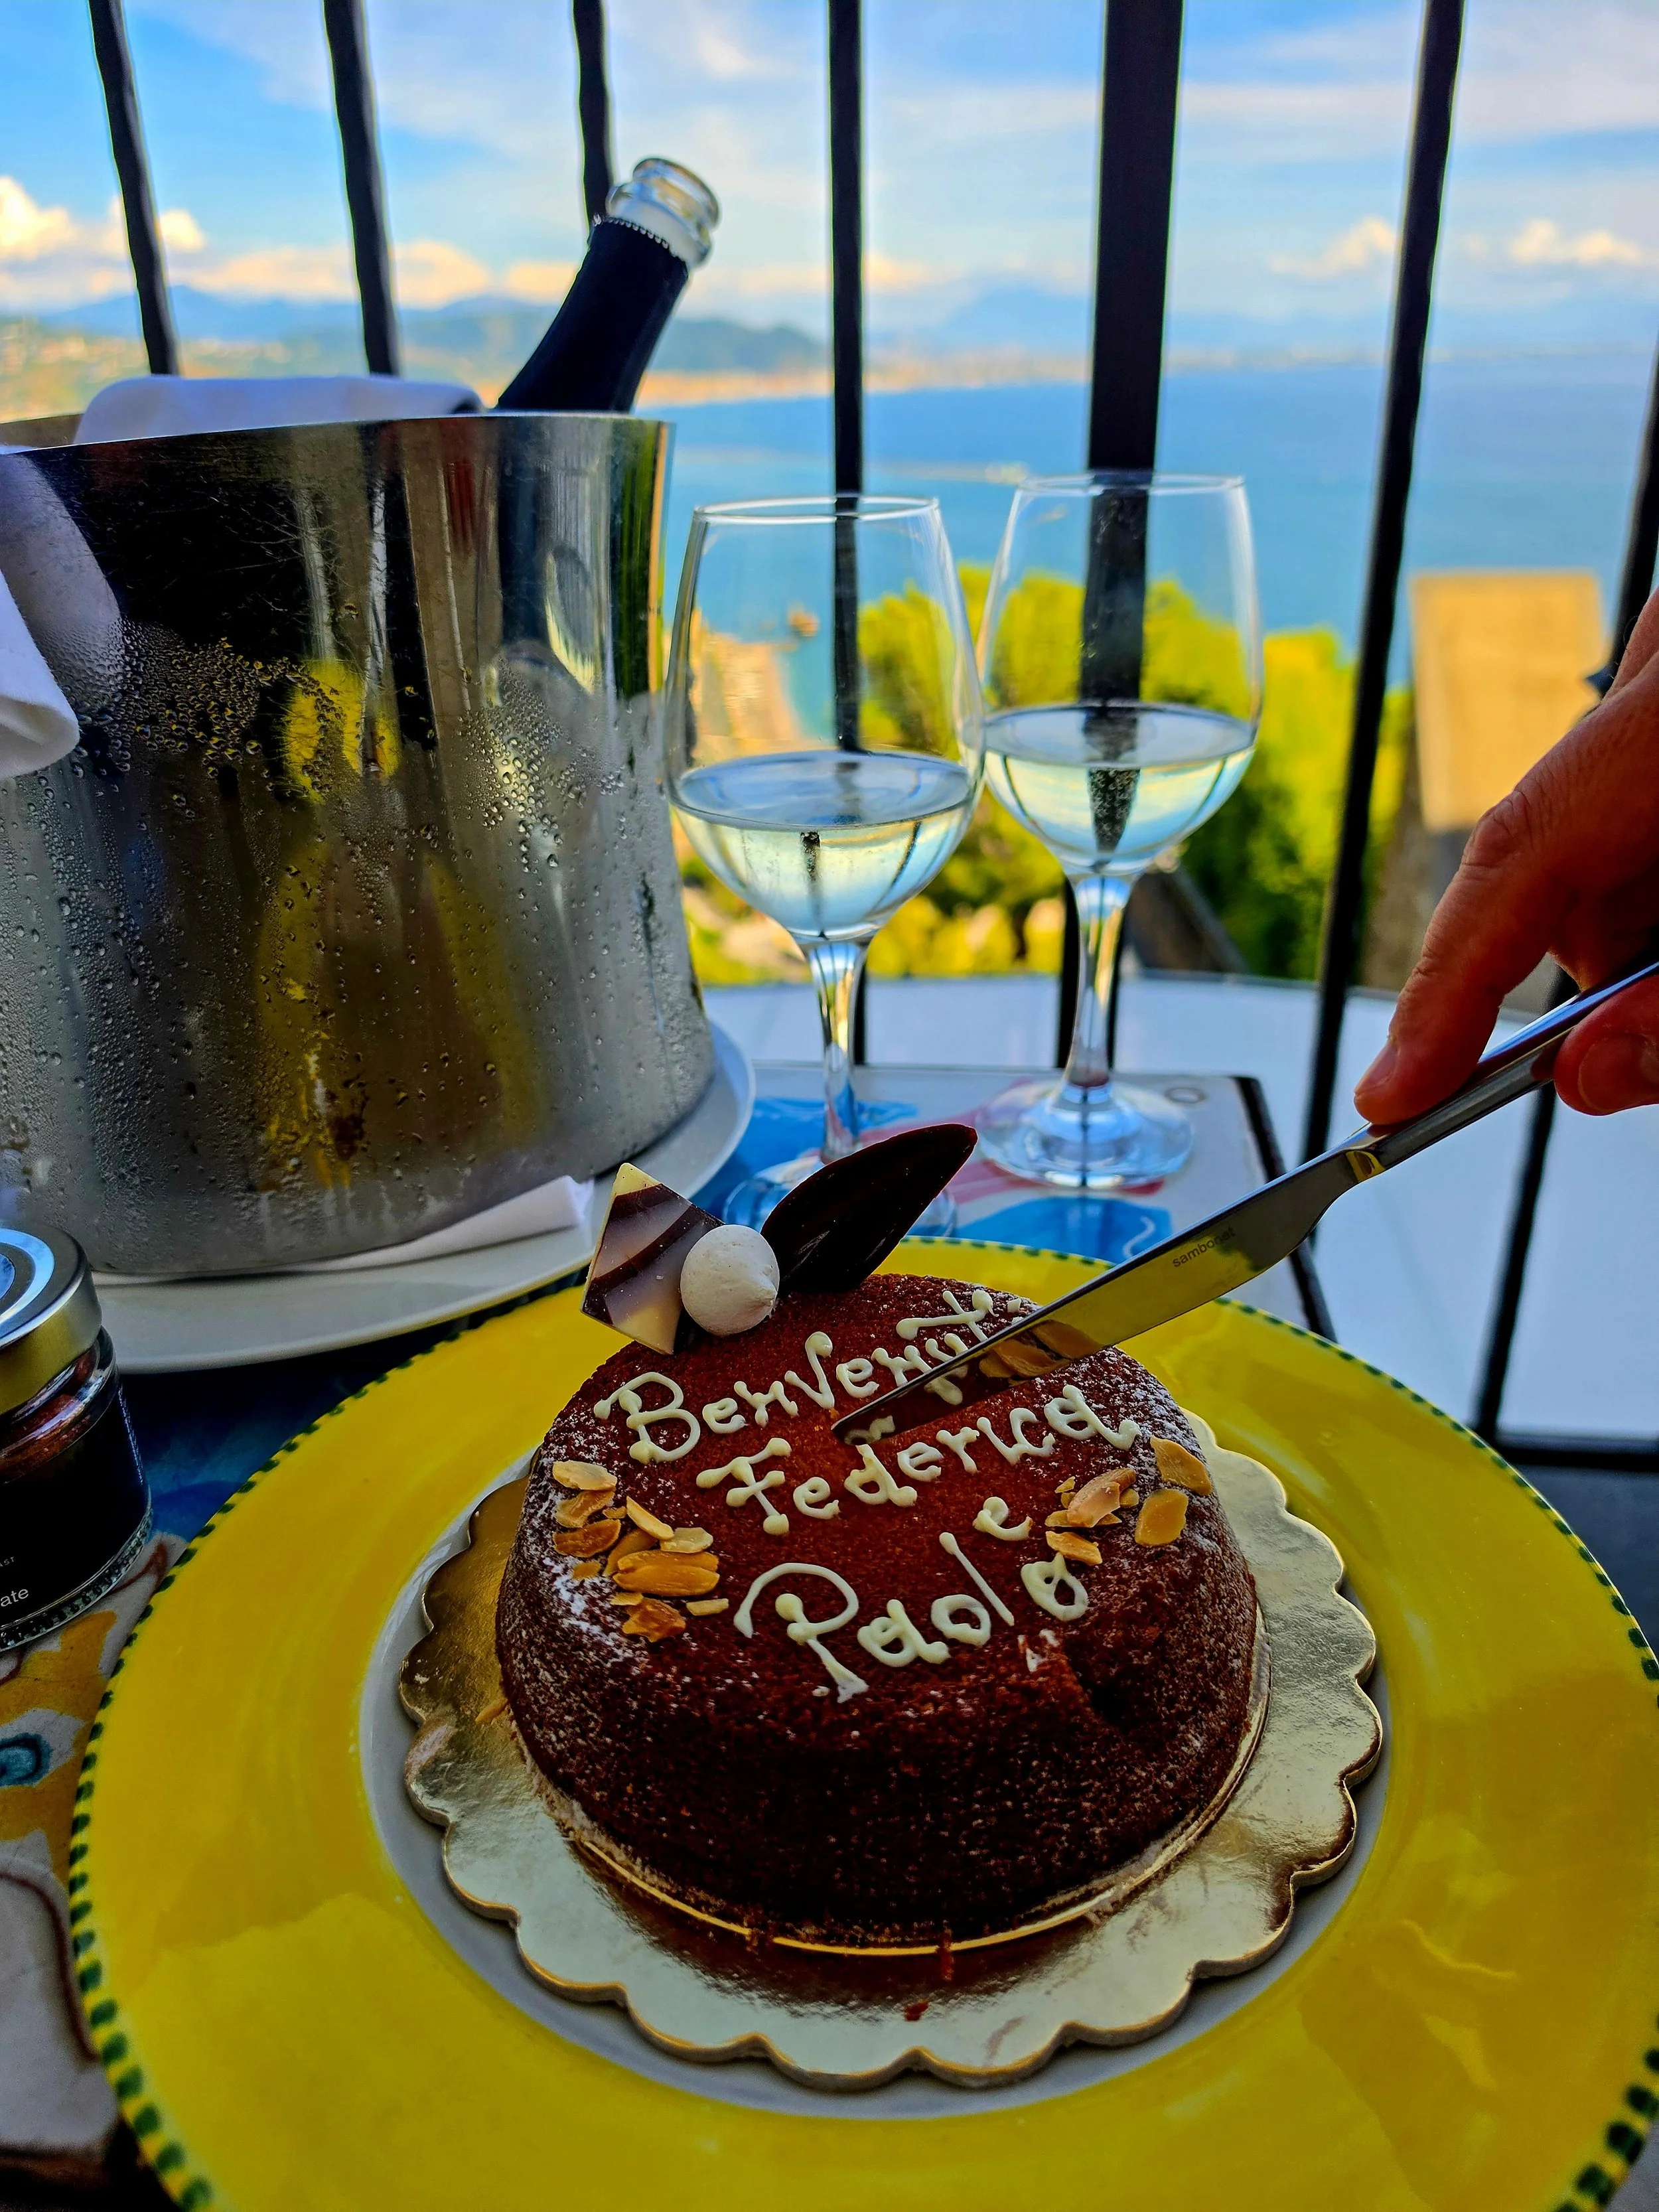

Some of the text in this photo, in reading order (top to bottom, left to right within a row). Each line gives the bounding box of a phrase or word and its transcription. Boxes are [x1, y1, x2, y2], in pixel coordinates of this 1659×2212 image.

[1172, 1226, 1236, 1268] sambonet
[695, 1384, 1142, 1536] Federica
[733, 1532, 1089, 1704] Paolo
